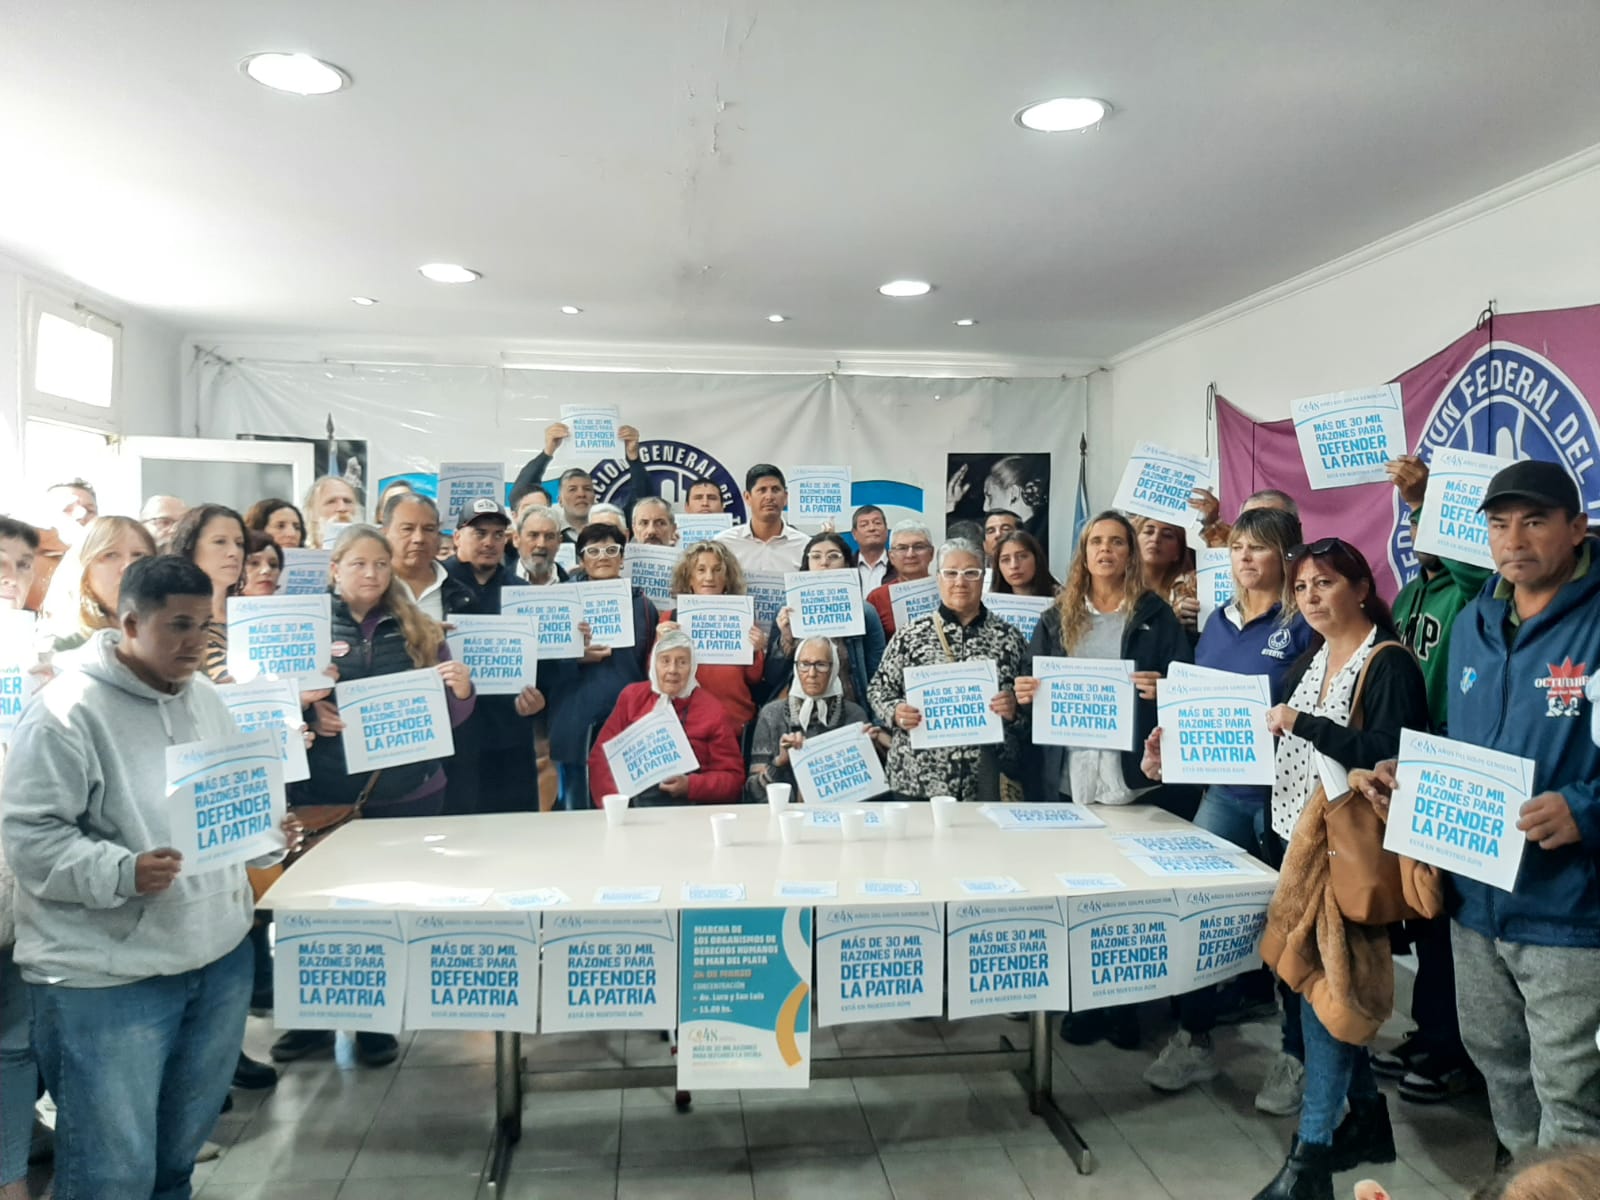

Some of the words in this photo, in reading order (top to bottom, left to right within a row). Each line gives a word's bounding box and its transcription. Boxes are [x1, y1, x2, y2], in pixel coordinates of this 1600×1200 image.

[1314, 419, 1333, 432] MÁS
[1336, 420, 1347, 429] DE
[1350, 417, 1362, 426] 30
[1366, 414, 1382, 424] MIL
[1460, 360, 1559, 423] FEDERAL
[1555, 412, 1594, 485] DEL
[1316, 429, 1356, 441] RAZONES
[1358, 425, 1383, 435] PARA
[1319, 435, 1386, 456] DEFENDER
[640, 445, 716, 479] GENERAL
[1322, 456, 1340, 469] LA
[1342, 450, 1390, 467] PATRIA
[923, 687, 940, 697] MÁS
[1052, 680, 1071, 690] MÁS
[1087, 684, 1098, 692] 30
[924, 696, 959, 705] RAZONES
[1052, 692, 1090, 700] RAZONES
[925, 702, 984, 718] DEFENDER
[1052, 702, 1117, 716] DEFENDER
[1179, 706, 1200, 718] MÁS
[1203, 709, 1214, 717] DE
[1218, 708, 1230, 717] 30
[1234, 708, 1251, 716] MIL
[926, 719, 942, 730] LA
[944, 715, 986, 729] PATRIA
[1052, 715, 1068, 726] LA
[1071, 716, 1117, 730] PATRIA
[1179, 719, 1222, 728] RAZONES
[1226, 719, 1251, 728] PARA
[1180, 730, 1254, 745] DEFENDER
[1181, 748, 1200, 762] LA
[1203, 747, 1256, 762] PATRIA
[194, 776, 217, 794] MÁS
[220, 775, 230, 787] DE
[234, 771, 248, 784] 30
[252, 767, 266, 779] MIL
[1421, 770, 1446, 786] MÁS
[1450, 778, 1463, 791] DE
[1468, 783, 1483, 796] 30
[1486, 789, 1505, 803] MIL
[196, 786, 240, 808] RAZONES
[243, 780, 267, 795] PARA
[1418, 784, 1470, 806] RAZONES
[1473, 798, 1504, 816] PARA
[197, 794, 270, 829] DEFENDER
[1415, 797, 1504, 837] DEFENDER
[198, 829, 218, 850] LA
[222, 813, 271, 844] PATRIA
[1412, 816, 1433, 836] LA
[1437, 823, 1498, 857] PATRIA
[970, 930, 992, 944] MÁS
[996, 932, 1008, 942] DE
[1012, 930, 1026, 941] 30
[1029, 929, 1046, 939] MIL
[1091, 924, 1113, 938] MÁS
[1117, 925, 1128, 935] DE
[1133, 923, 1146, 934] 30
[1149, 922, 1166, 932] MIL
[299, 940, 325, 954] MÁS
[329, 944, 342, 954] DE
[347, 944, 362, 955] 30
[365, 945, 384, 955] MIL
[568, 942, 594, 955] MÁS
[598, 944, 612, 955] DE
[616, 944, 631, 955] 30
[635, 944, 654, 954] MIL
[694, 936, 708, 945] LOS
[970, 943, 1016, 956] RAZONES
[1020, 941, 1046, 952] PARA
[1091, 936, 1136, 950] RAZONES
[1140, 934, 1166, 944] PARA
[299, 956, 351, 967] RAZONES
[355, 957, 384, 968] PARA
[568, 957, 620, 968] RAZONES
[625, 956, 654, 967] PARA
[742, 956, 768, 964] PLATA
[970, 954, 1048, 974] DEFENDER
[1092, 946, 1168, 967] DEFENDER
[300, 970, 386, 986] DEFENDER
[568, 970, 656, 986] DEFENDER
[1092, 968, 1112, 984] LA
[1115, 962, 1167, 982] PATRIA
[970, 976, 990, 992] LA
[994, 971, 1048, 990] PATRIA
[300, 988, 322, 1004] LA
[326, 988, 385, 1006] PATRIA
[568, 989, 590, 1006] LA
[595, 988, 656, 1005] PATRIA
